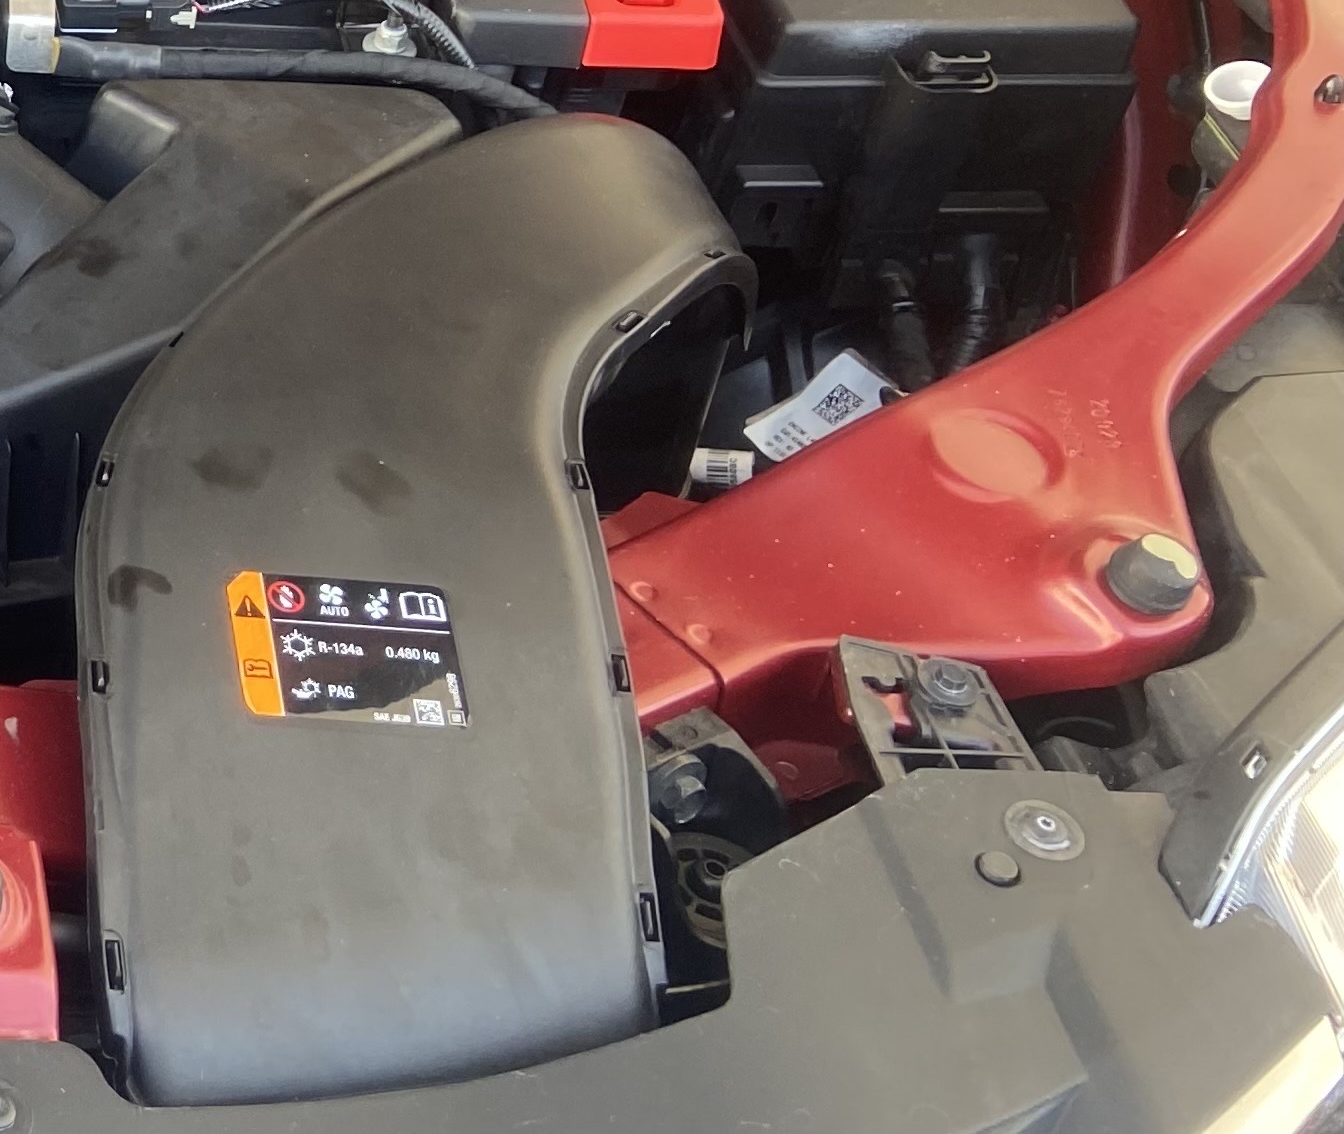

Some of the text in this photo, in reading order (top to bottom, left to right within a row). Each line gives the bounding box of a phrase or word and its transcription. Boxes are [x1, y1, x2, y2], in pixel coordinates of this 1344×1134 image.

[320, 605, 349, 617] AUTO
[317, 641, 440, 663] R-134a 0.480 kg
[328, 685, 355, 698] PAG
